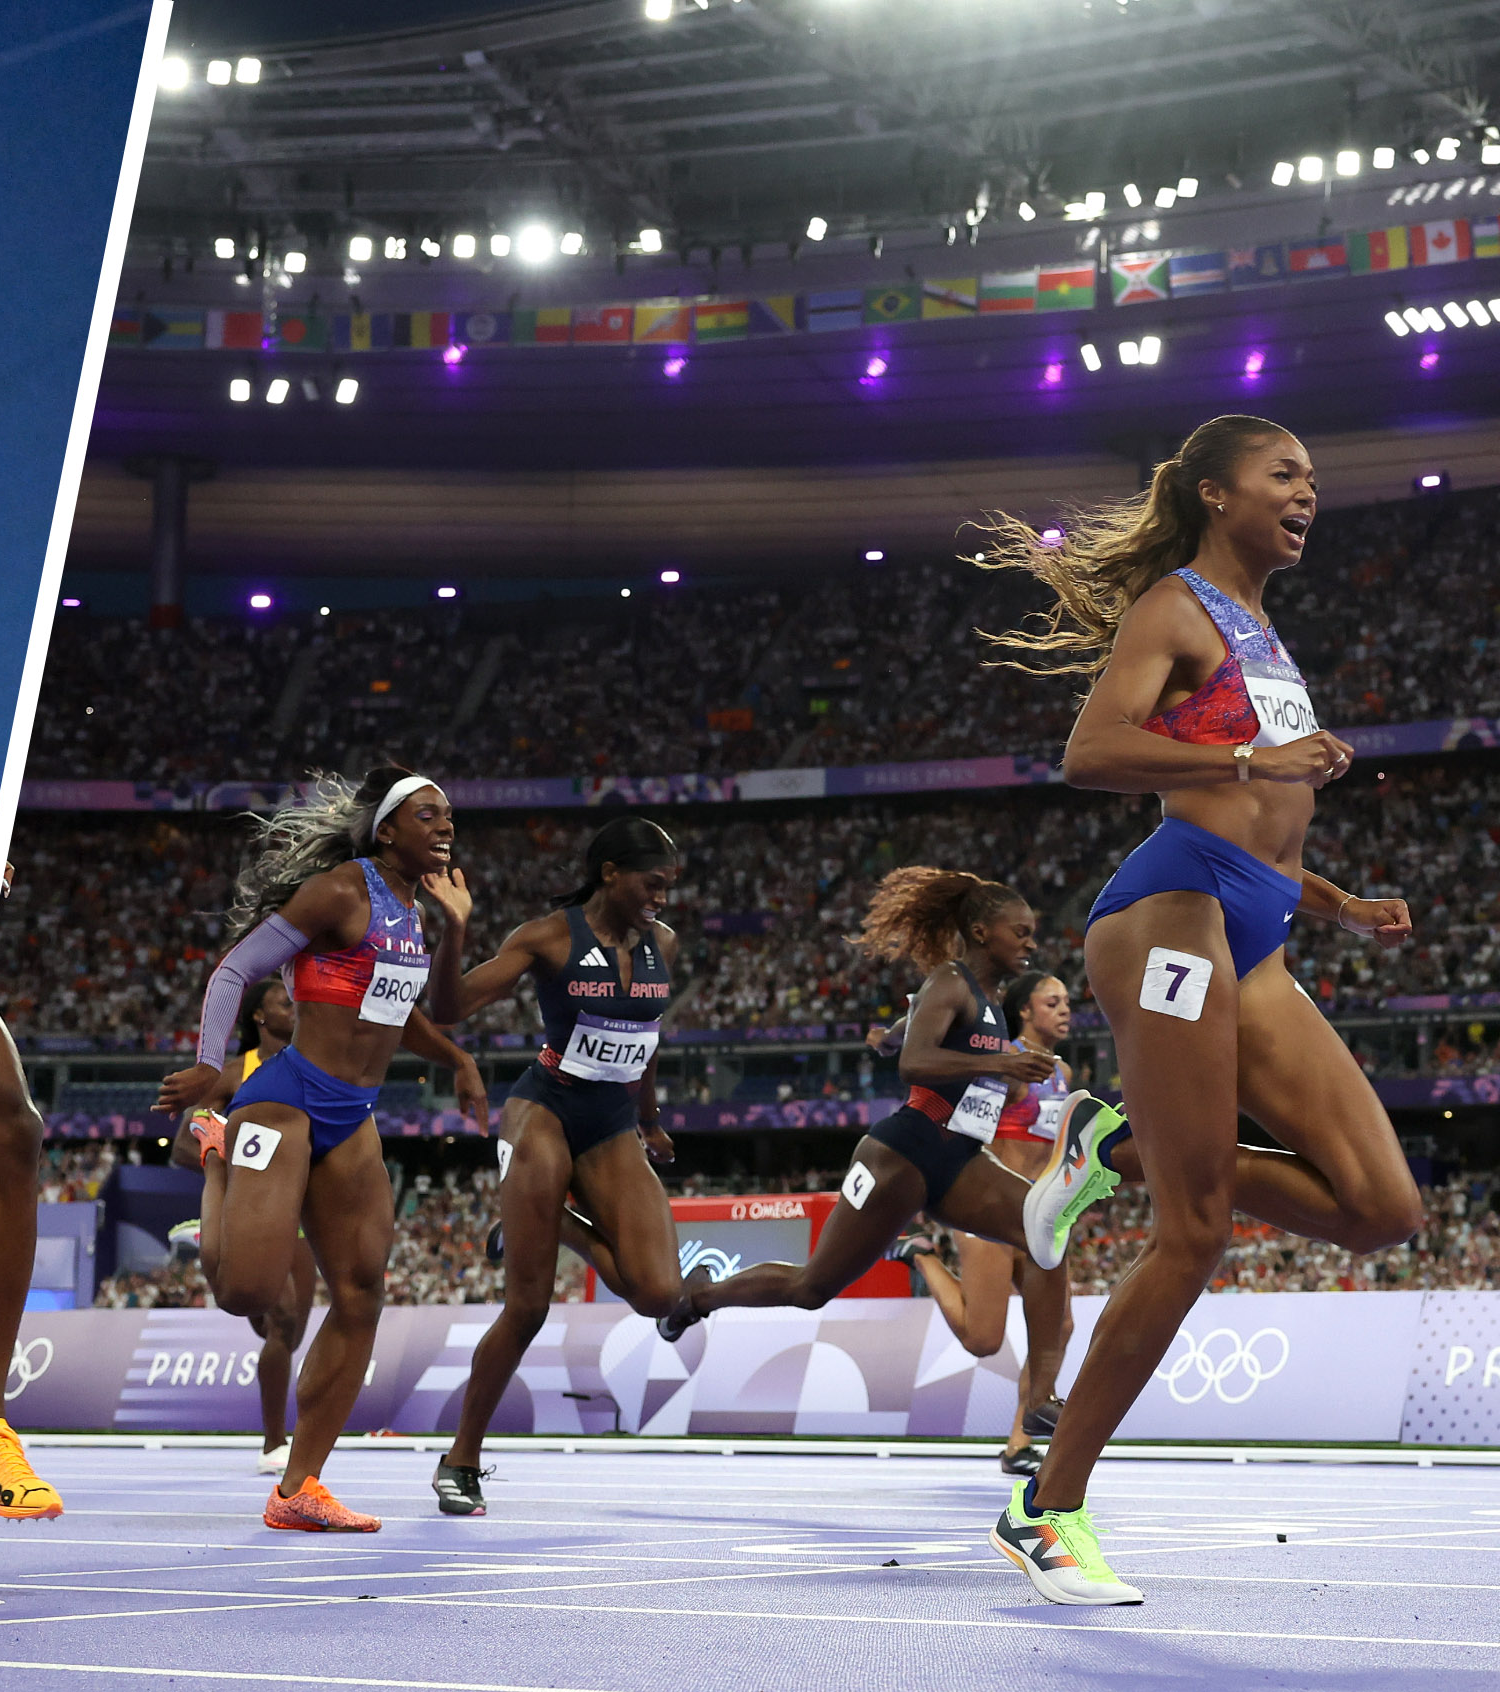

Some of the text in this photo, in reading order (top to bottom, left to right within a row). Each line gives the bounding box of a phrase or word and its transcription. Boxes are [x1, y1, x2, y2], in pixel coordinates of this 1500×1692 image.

[568, 980, 616, 998] GREAT
[1165, 963, 1191, 1002] 7
[576, 1034, 646, 1065] NEITA
[242, 1134, 261, 1158] 6
[853, 1173, 863, 1197] 4
[749, 1202, 806, 1219] OMEGA
